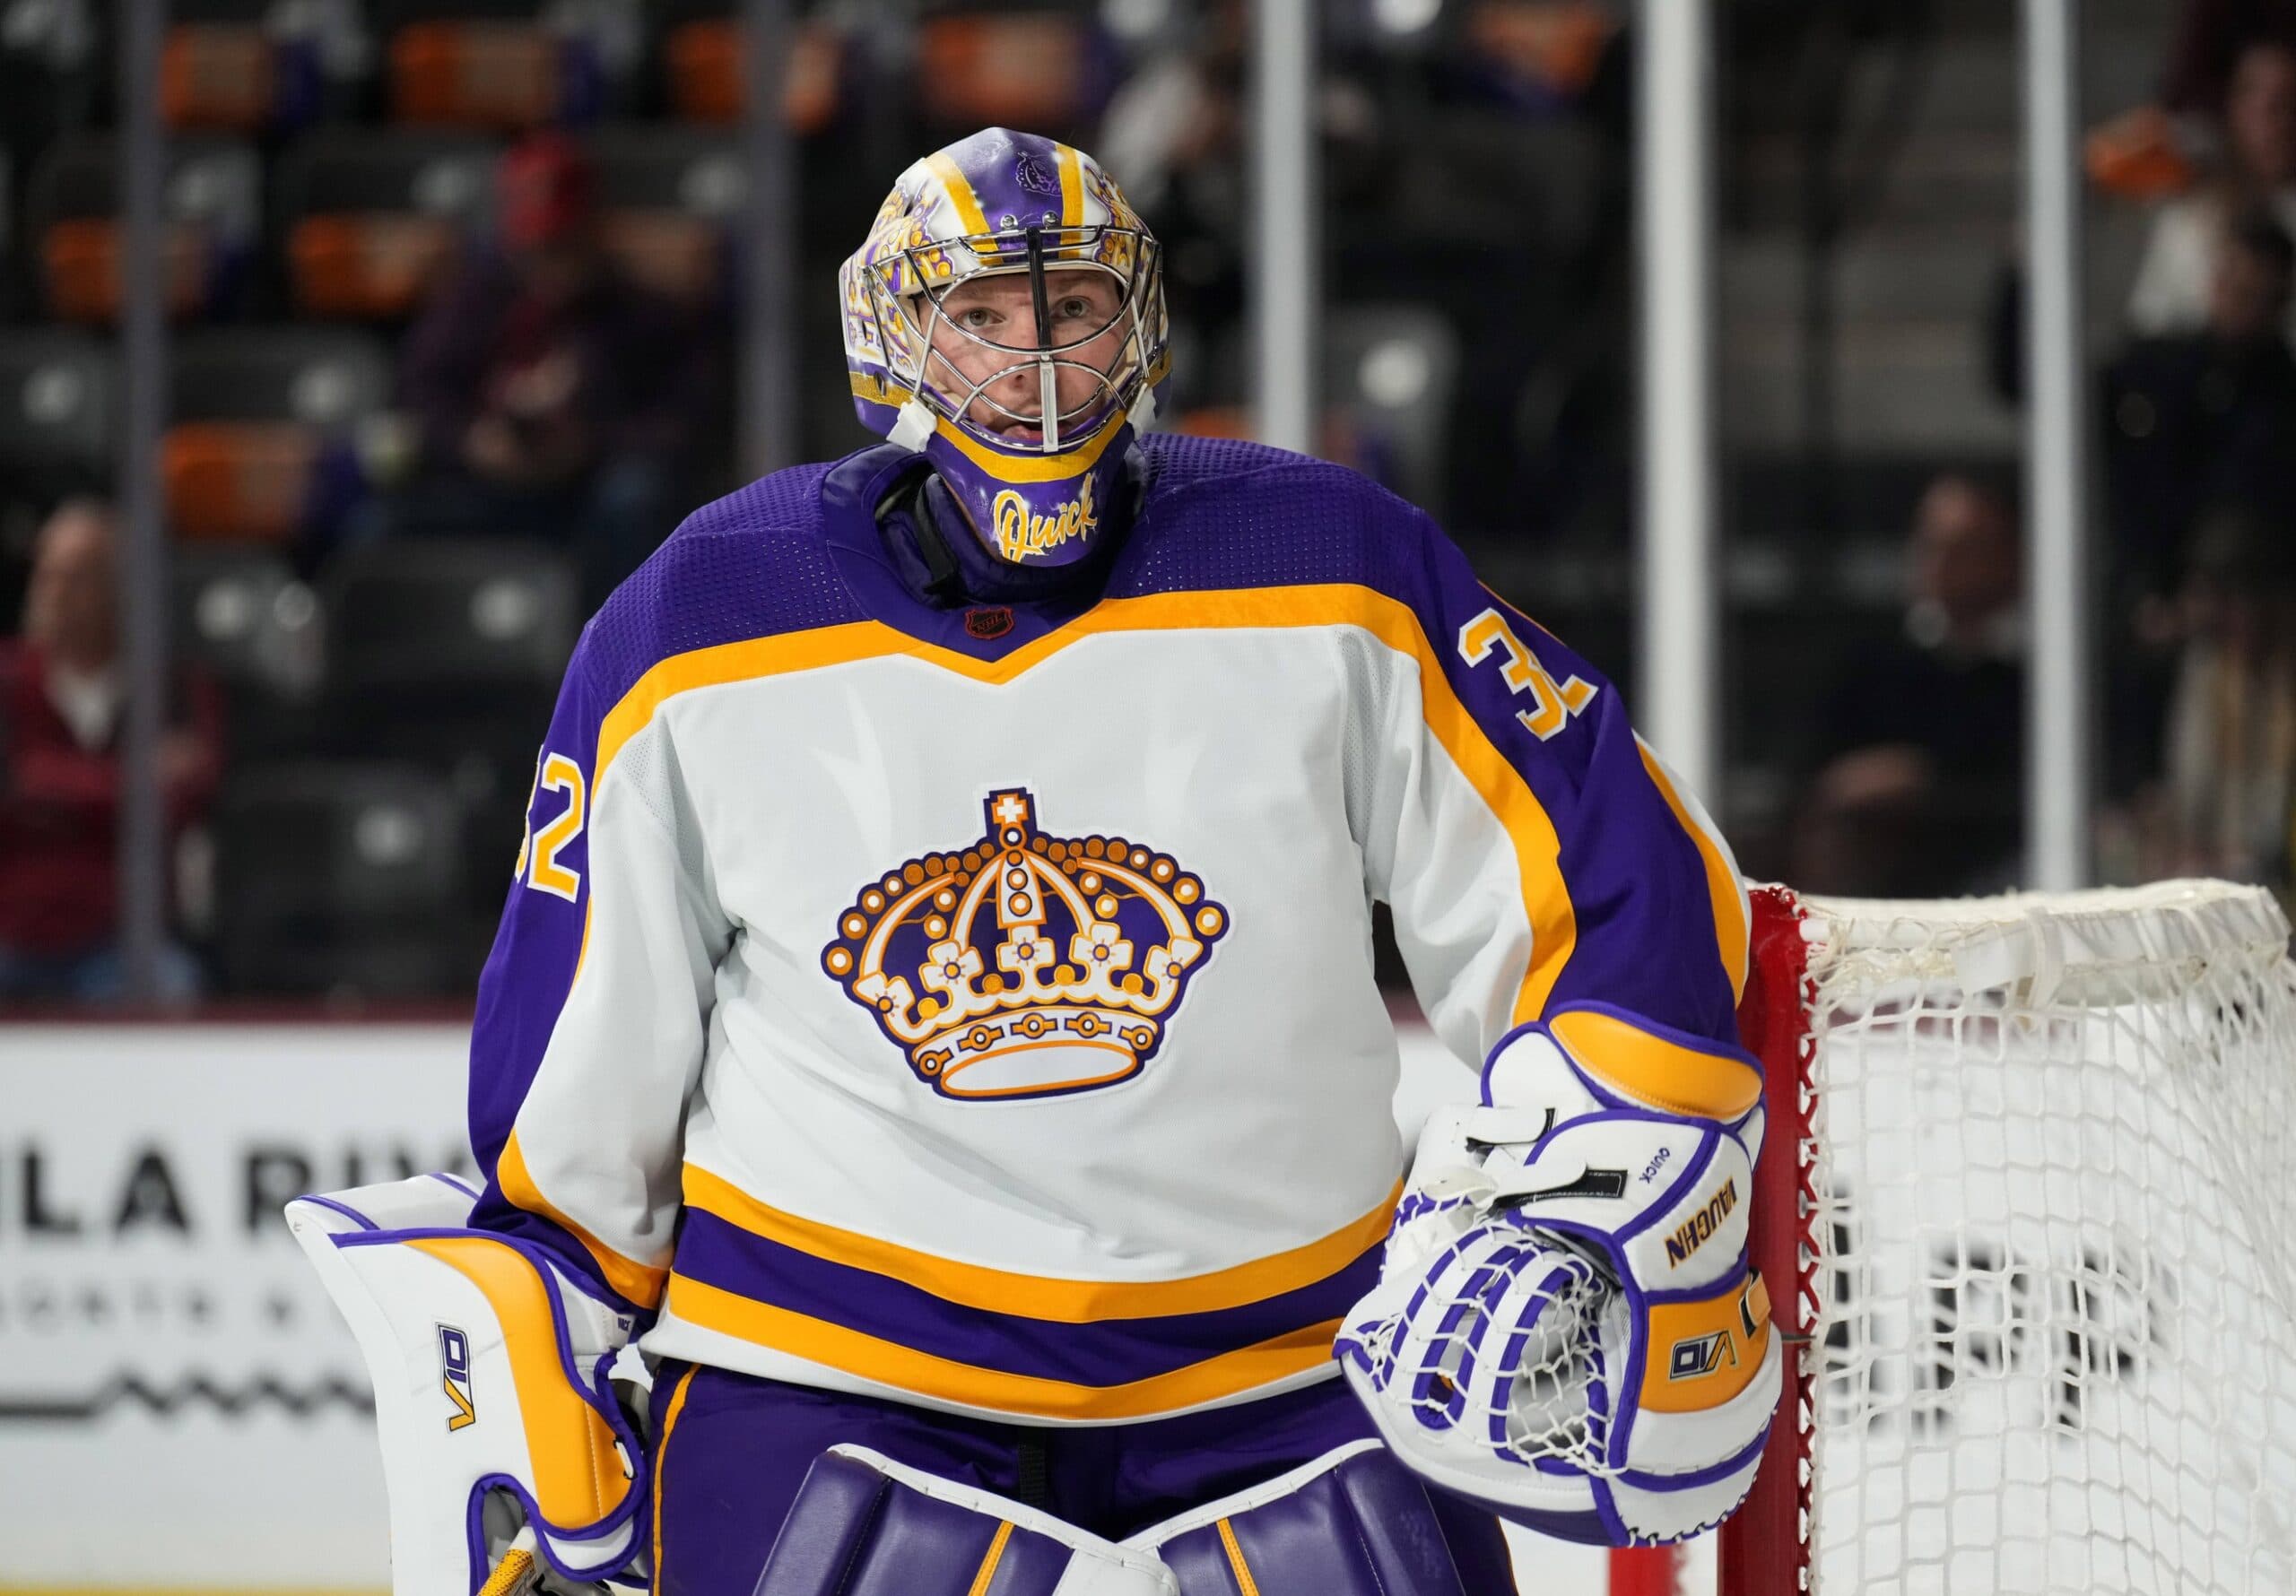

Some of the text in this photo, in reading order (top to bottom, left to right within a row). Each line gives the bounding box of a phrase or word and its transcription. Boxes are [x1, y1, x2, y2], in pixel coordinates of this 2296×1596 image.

[994, 473, 1098, 563] Quick
[515, 744, 586, 905] 2
[1639, 1147, 1671, 1184] QUICK
[1664, 1175, 1738, 1271] VAUGHN
